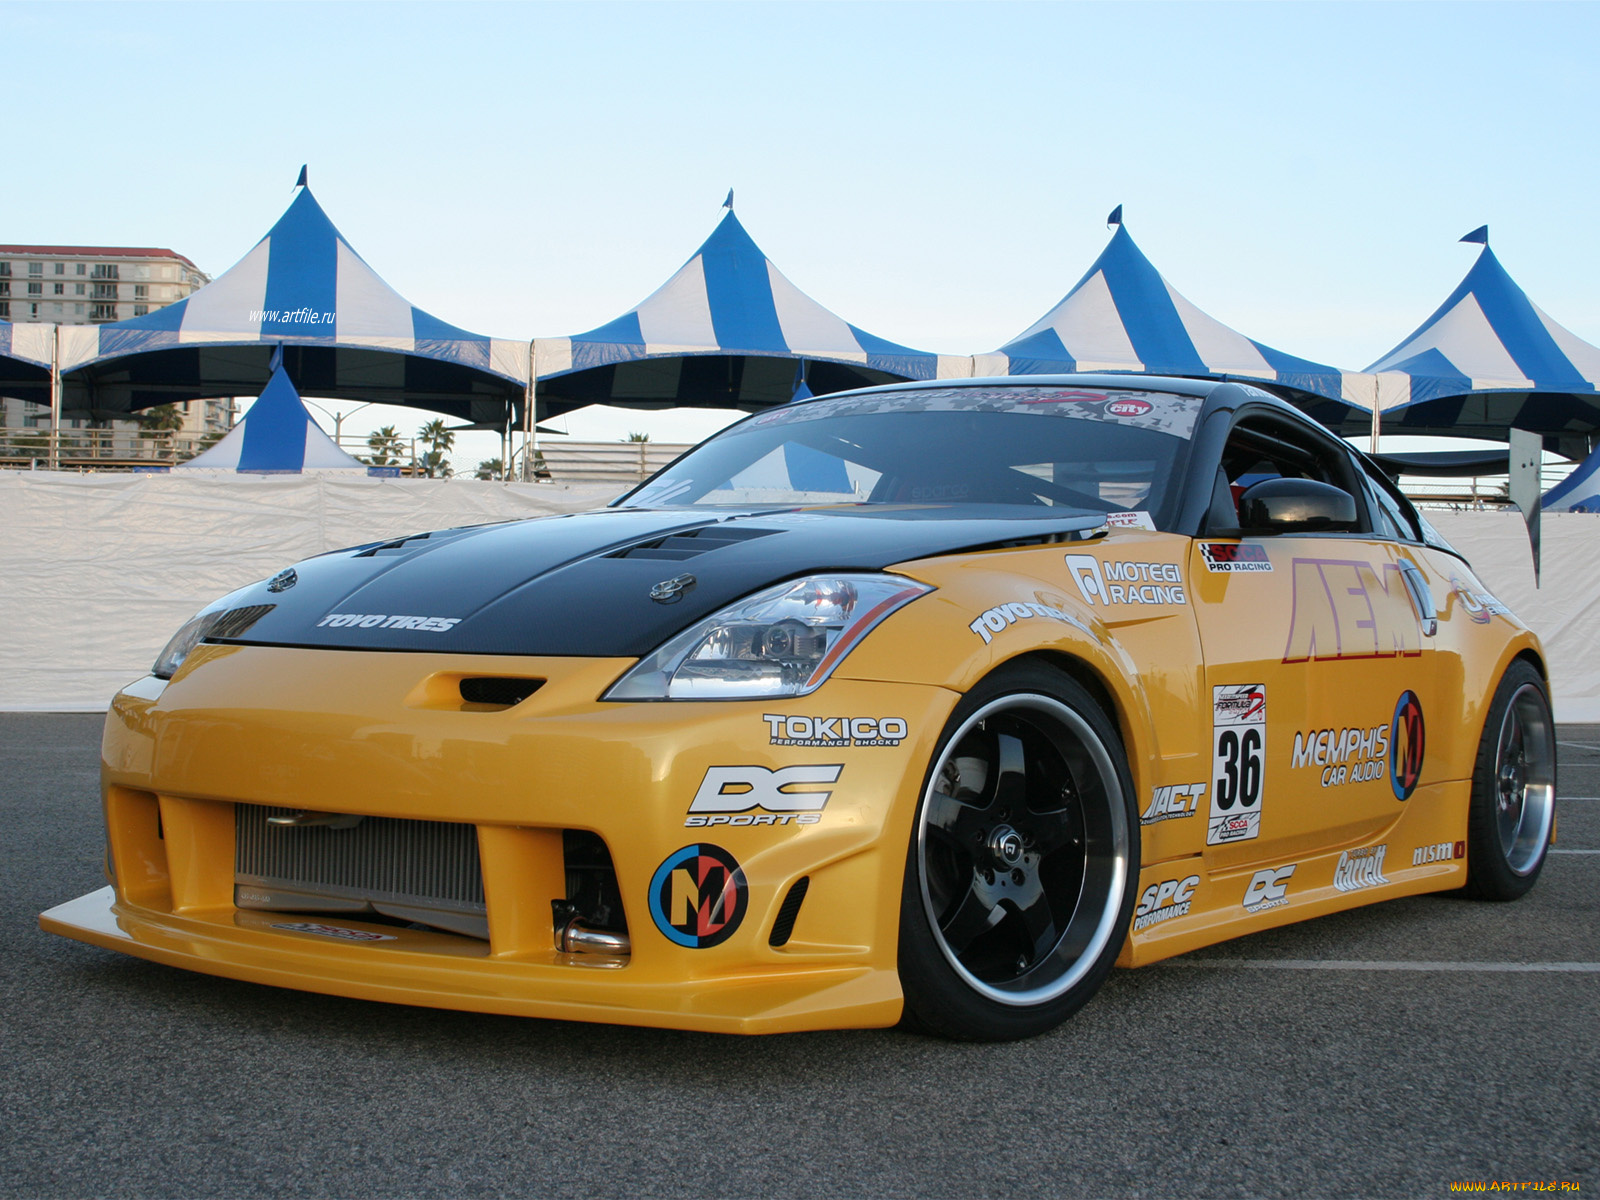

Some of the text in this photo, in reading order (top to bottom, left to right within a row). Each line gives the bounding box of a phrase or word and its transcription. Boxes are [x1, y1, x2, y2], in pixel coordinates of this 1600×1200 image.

[1210, 545, 1270, 562] SCCA
[1103, 561, 1182, 583] MOTEGI
[1209, 563, 1272, 571] PRO RACING
[1108, 585, 1186, 605] RACING
[316, 614, 463, 632] TOYO TIRES
[968, 602, 1034, 645] TOYO
[763, 713, 908, 740] TOKICO
[769, 739, 900, 747] PERFORMANCE SHOCKS
[1291, 724, 1389, 768] MEMPHIS
[1217, 728, 1261, 811] 36
[1321, 761, 1385, 787] CAR AUDIO
[687, 764, 845, 814] DC
[684, 814, 822, 827] SPORTS
[1229, 820, 1248, 829] SCCA
[1412, 841, 1465, 866] nismo
[1333, 844, 1391, 893] Garrett
[1136, 875, 1200, 916] SPC
[1243, 864, 1297, 907] DC
[1133, 900, 1192, 931] PERFORMANCE
[1247, 899, 1290, 913] SPORTS
